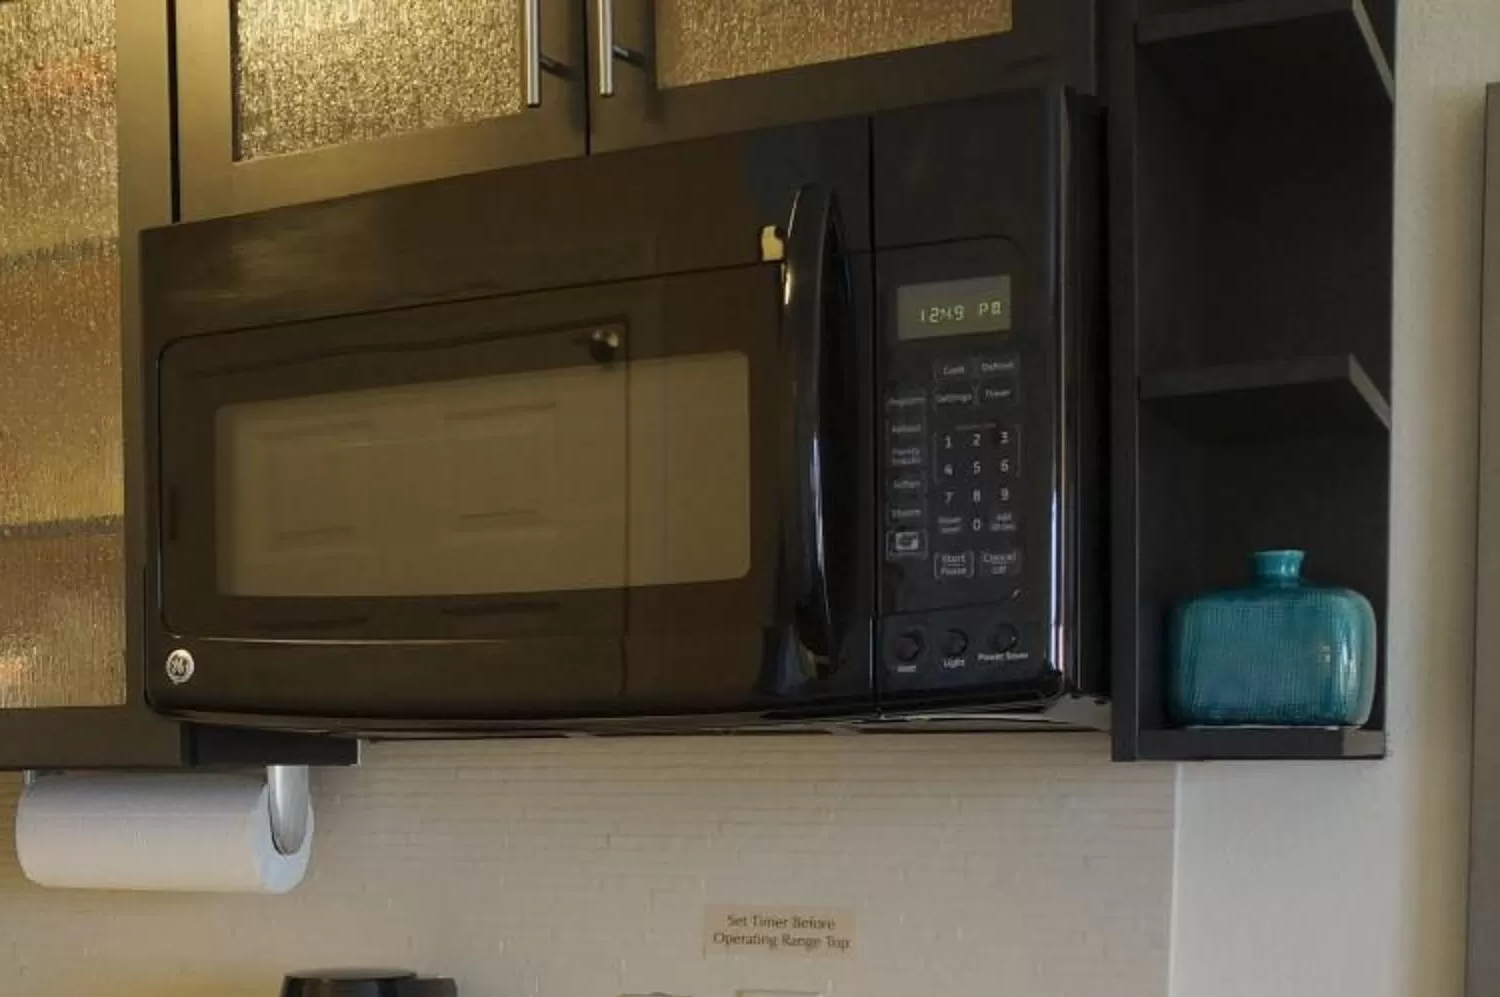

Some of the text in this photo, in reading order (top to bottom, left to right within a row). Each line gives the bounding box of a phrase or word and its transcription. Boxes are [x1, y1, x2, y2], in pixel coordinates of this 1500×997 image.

[944, 431, 1009, 449] 1 2 3
[944, 459, 1009, 476] 4 5 6
[973, 488, 981, 502] 8
[1000, 487, 1009, 501] 9
[973, 518, 981, 532] 0
[727, 914, 836, 930] Set Timer Before
[712, 931, 778, 950] Operating
